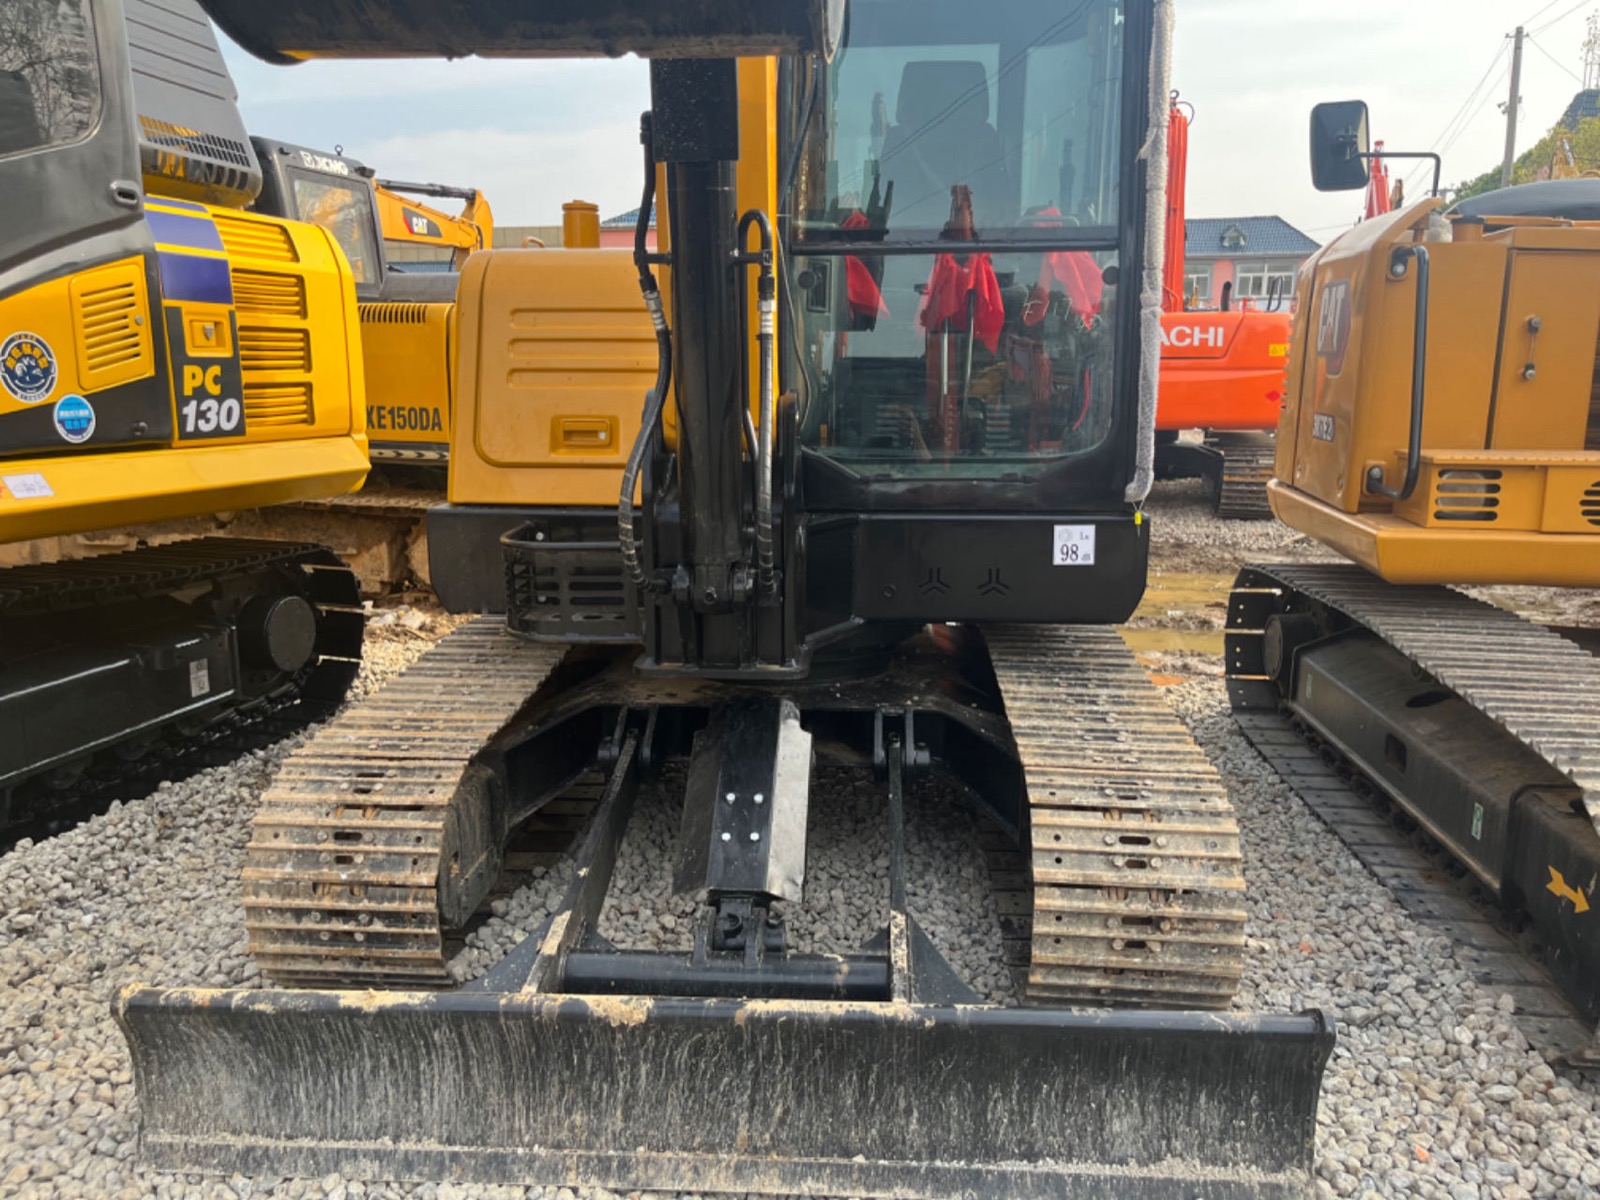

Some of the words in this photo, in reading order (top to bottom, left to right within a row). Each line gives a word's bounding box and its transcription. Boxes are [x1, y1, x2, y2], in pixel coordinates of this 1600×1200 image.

[412, 217, 428, 234] CAT
[1317, 284, 1346, 352] CAT
[183, 364, 222, 396] PC
[182, 398, 240, 432] 130
[366, 405, 443, 432] XE150DA
[1060, 543, 1079, 562] 98
